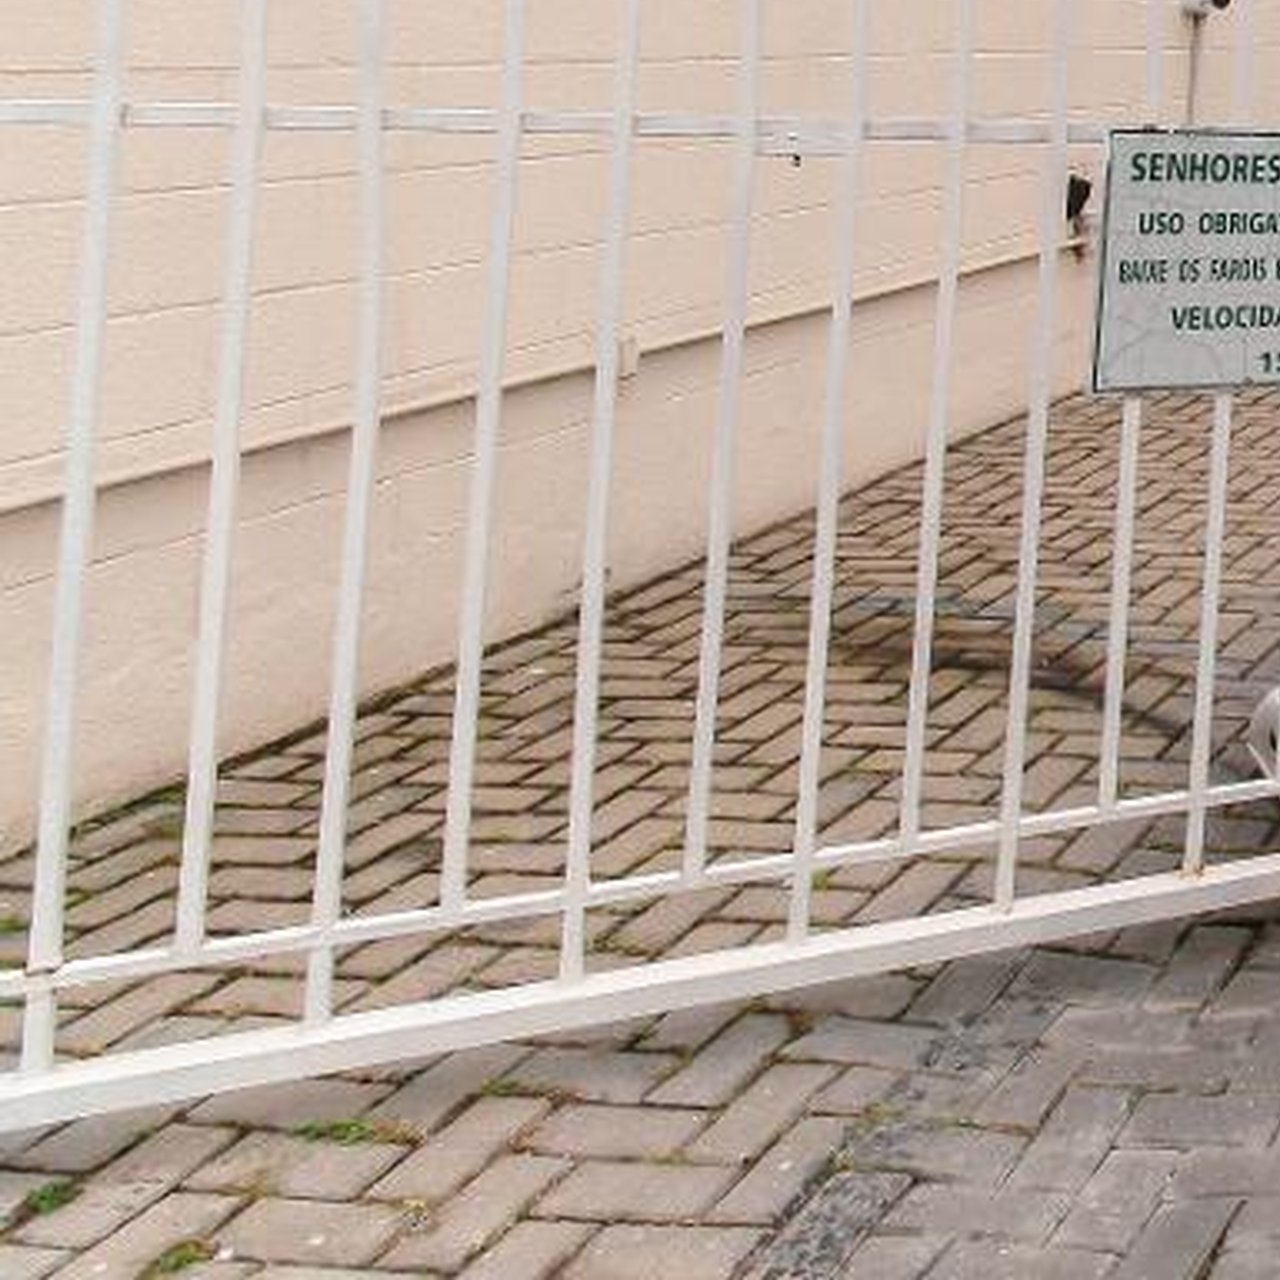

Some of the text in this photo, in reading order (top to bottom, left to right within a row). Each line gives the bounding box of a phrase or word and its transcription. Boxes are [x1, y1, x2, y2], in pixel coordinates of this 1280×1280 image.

[1139, 212, 1185, 235] USO
[1119, 258, 1169, 284] BAIXE
[1178, 258, 1200, 283] OS
